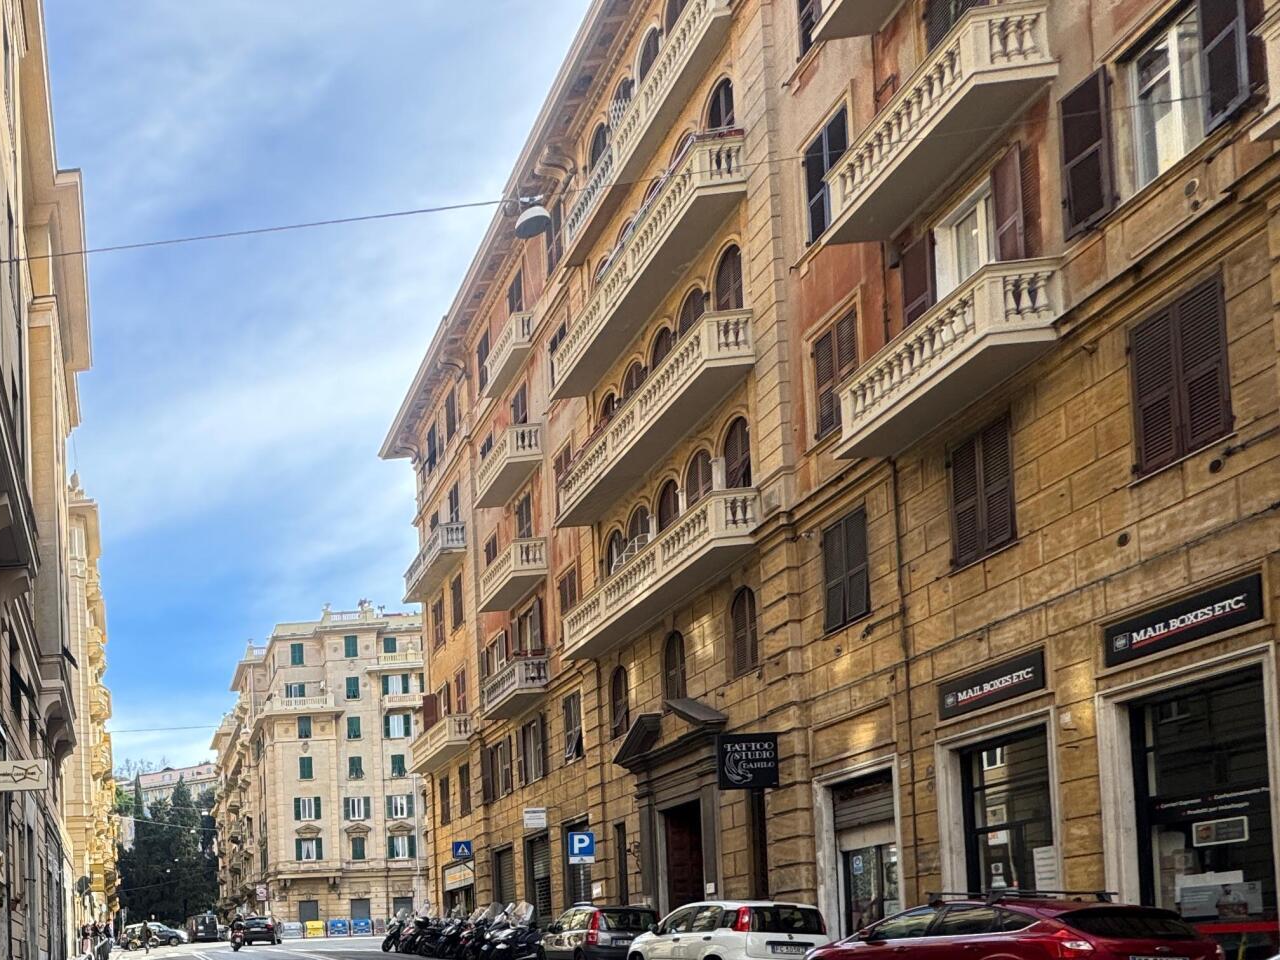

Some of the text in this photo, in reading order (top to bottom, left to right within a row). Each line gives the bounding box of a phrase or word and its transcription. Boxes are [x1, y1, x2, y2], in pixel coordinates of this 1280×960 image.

[1131, 622, 1169, 643] MAIL
[1169, 606, 1214, 631] BOXES
[957, 685, 982, 702] MAIL
[982, 675, 1013, 693] BOXES
[723, 742, 775, 751] TATTOO
[734, 750, 775, 760] STUDIO
[573, 834, 590, 854] P
